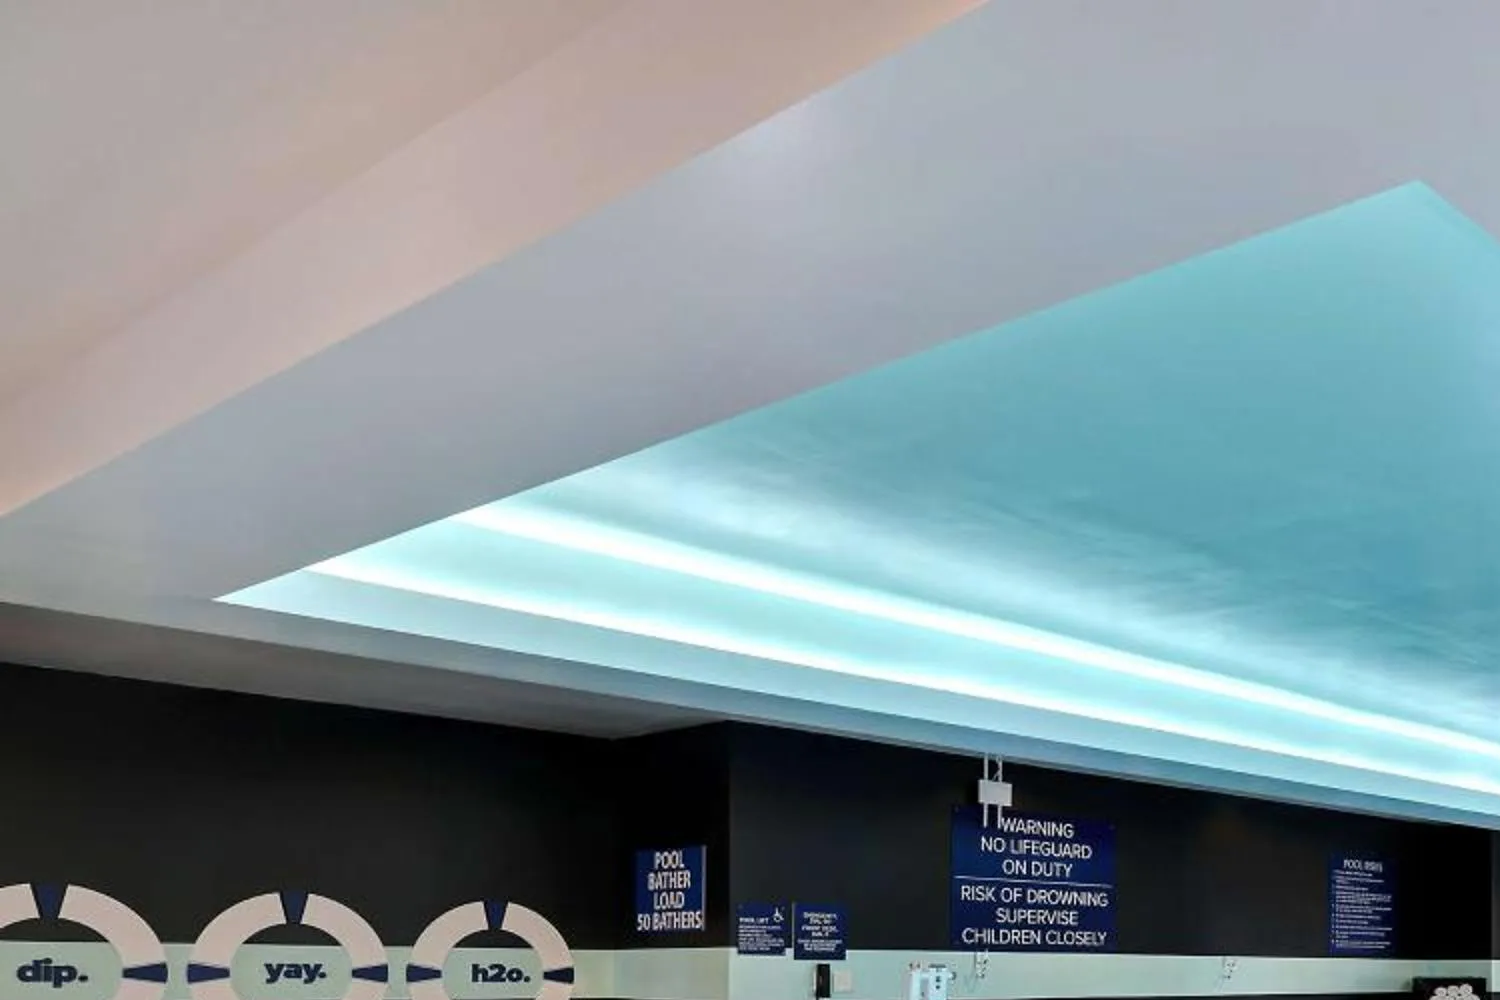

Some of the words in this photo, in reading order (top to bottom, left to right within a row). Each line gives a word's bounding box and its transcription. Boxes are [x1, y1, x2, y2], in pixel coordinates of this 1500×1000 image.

[1001, 817, 1074, 839] WARNING
[980, 836, 1007, 853] NO
[1010, 839, 1093, 860] LIFEGUARD
[653, 850, 685, 870] POOL
[1002, 859, 1027, 876] ON
[1031, 861, 1073, 878] DUTY
[647, 869, 691, 891] BATHER
[653, 891, 685, 910] LOAD
[960, 885, 997, 902] RISK
[1001, 887, 1023, 903] OF
[1027, 889, 1110, 907] DROWNING
[637, 913, 651, 931] 50
[652, 910, 703, 931] BATHERS
[995, 907, 1079, 926] SUPERVISE
[961, 927, 1041, 945] CHILDREN
[1045, 929, 1108, 946] CLOSELY
[16, 958, 89, 988] dip.
[263, 961, 327, 984] yay.
[471, 962, 531, 984] h2o.
